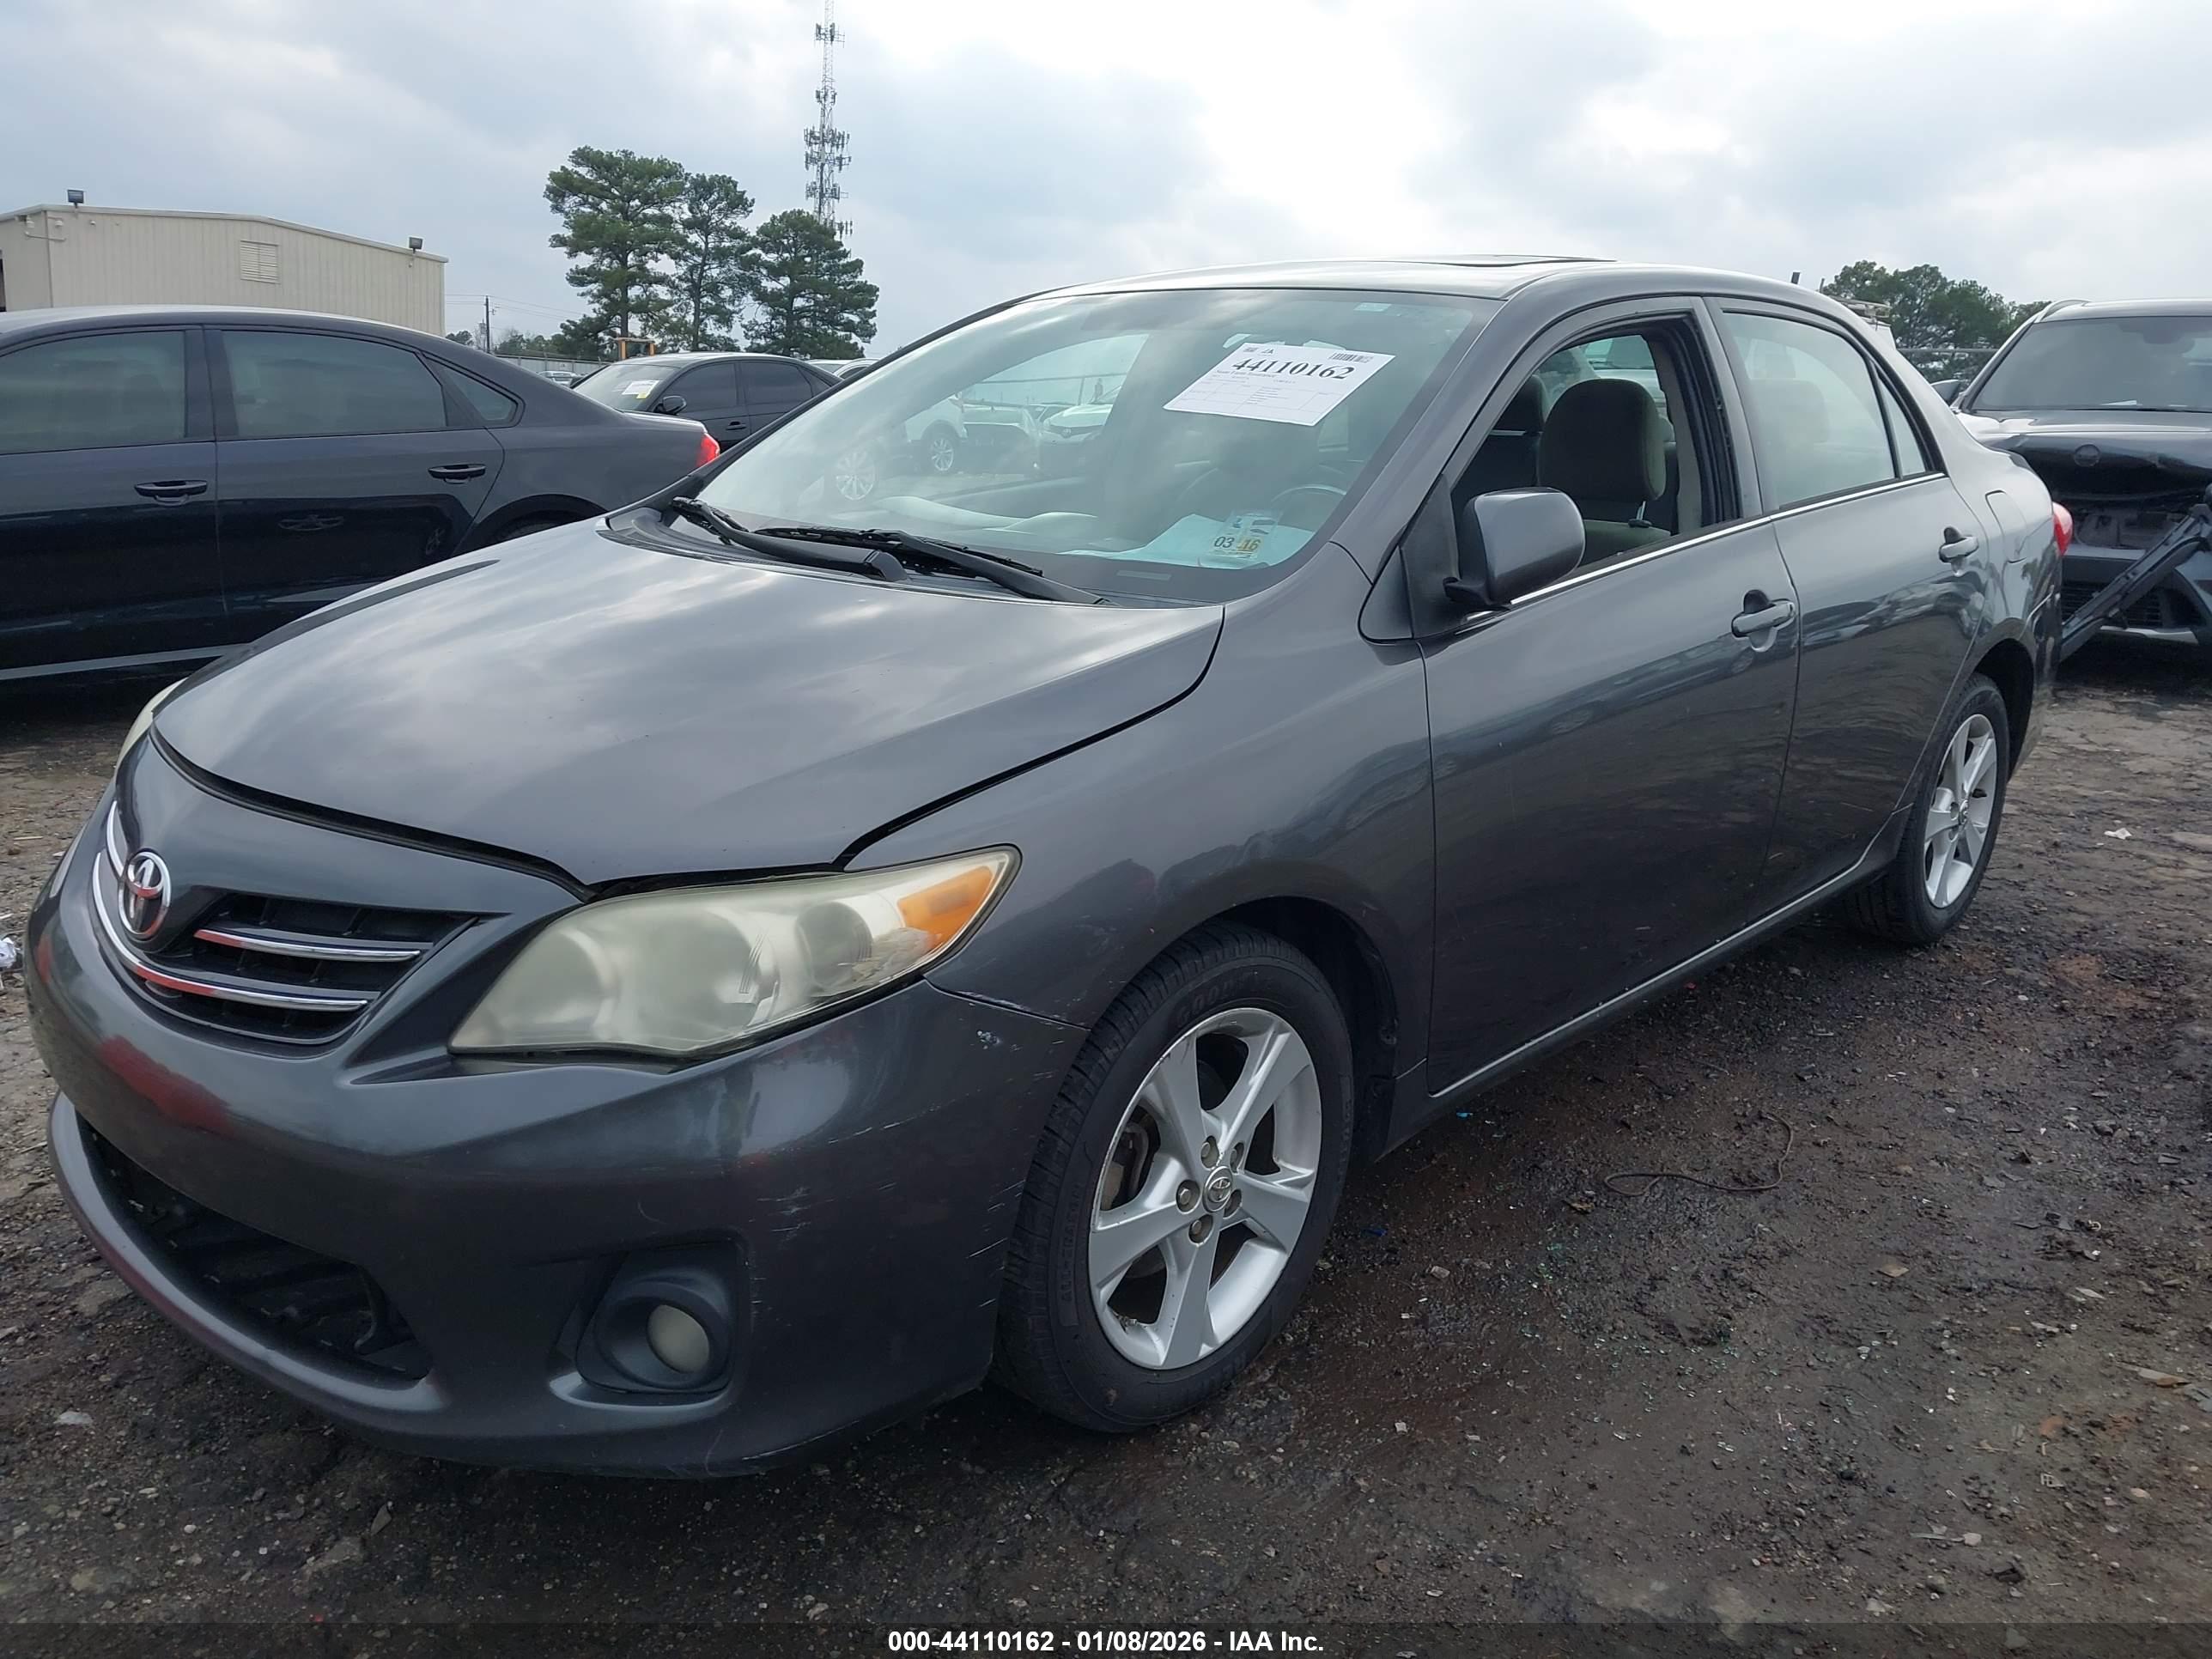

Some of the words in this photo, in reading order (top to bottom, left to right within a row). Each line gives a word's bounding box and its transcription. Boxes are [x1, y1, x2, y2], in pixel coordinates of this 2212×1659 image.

[1231, 358, 1355, 380] 44110162
[1213, 536, 1236, 549] 03
[1242, 538, 1262, 550] 16
